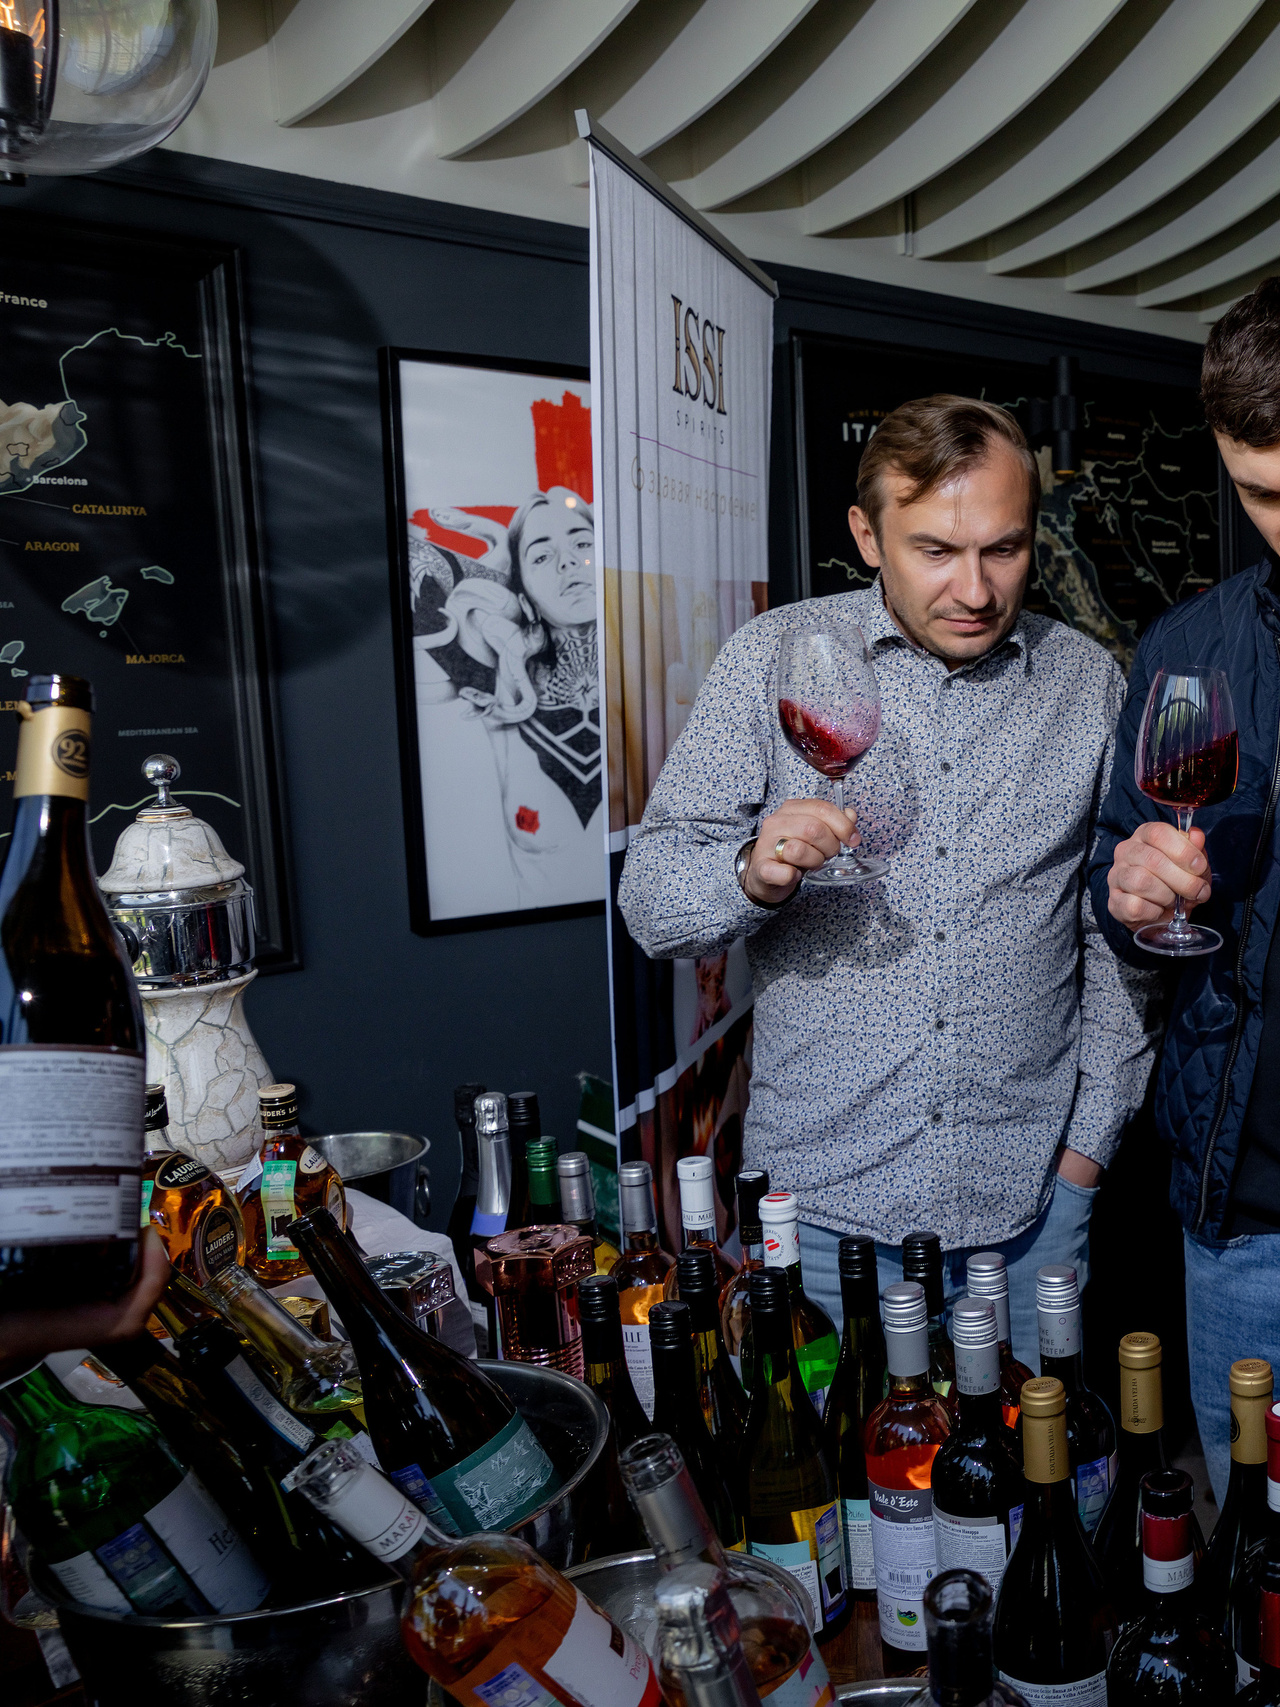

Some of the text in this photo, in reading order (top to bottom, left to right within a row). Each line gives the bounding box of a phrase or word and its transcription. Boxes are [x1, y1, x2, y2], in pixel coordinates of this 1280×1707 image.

[671, 294, 727, 416] ISSI
[676, 409, 725, 446] SPIRITS
[33, 475, 88, 486] Barcelona
[72, 504, 147, 516] CATALUNYA
[25, 541, 80, 552] ARAGON
[125, 653, 186, 664] MAJORCA
[205, 1230, 235, 1255] LAUDER'S
[874, 1490, 889, 1505] Vale
